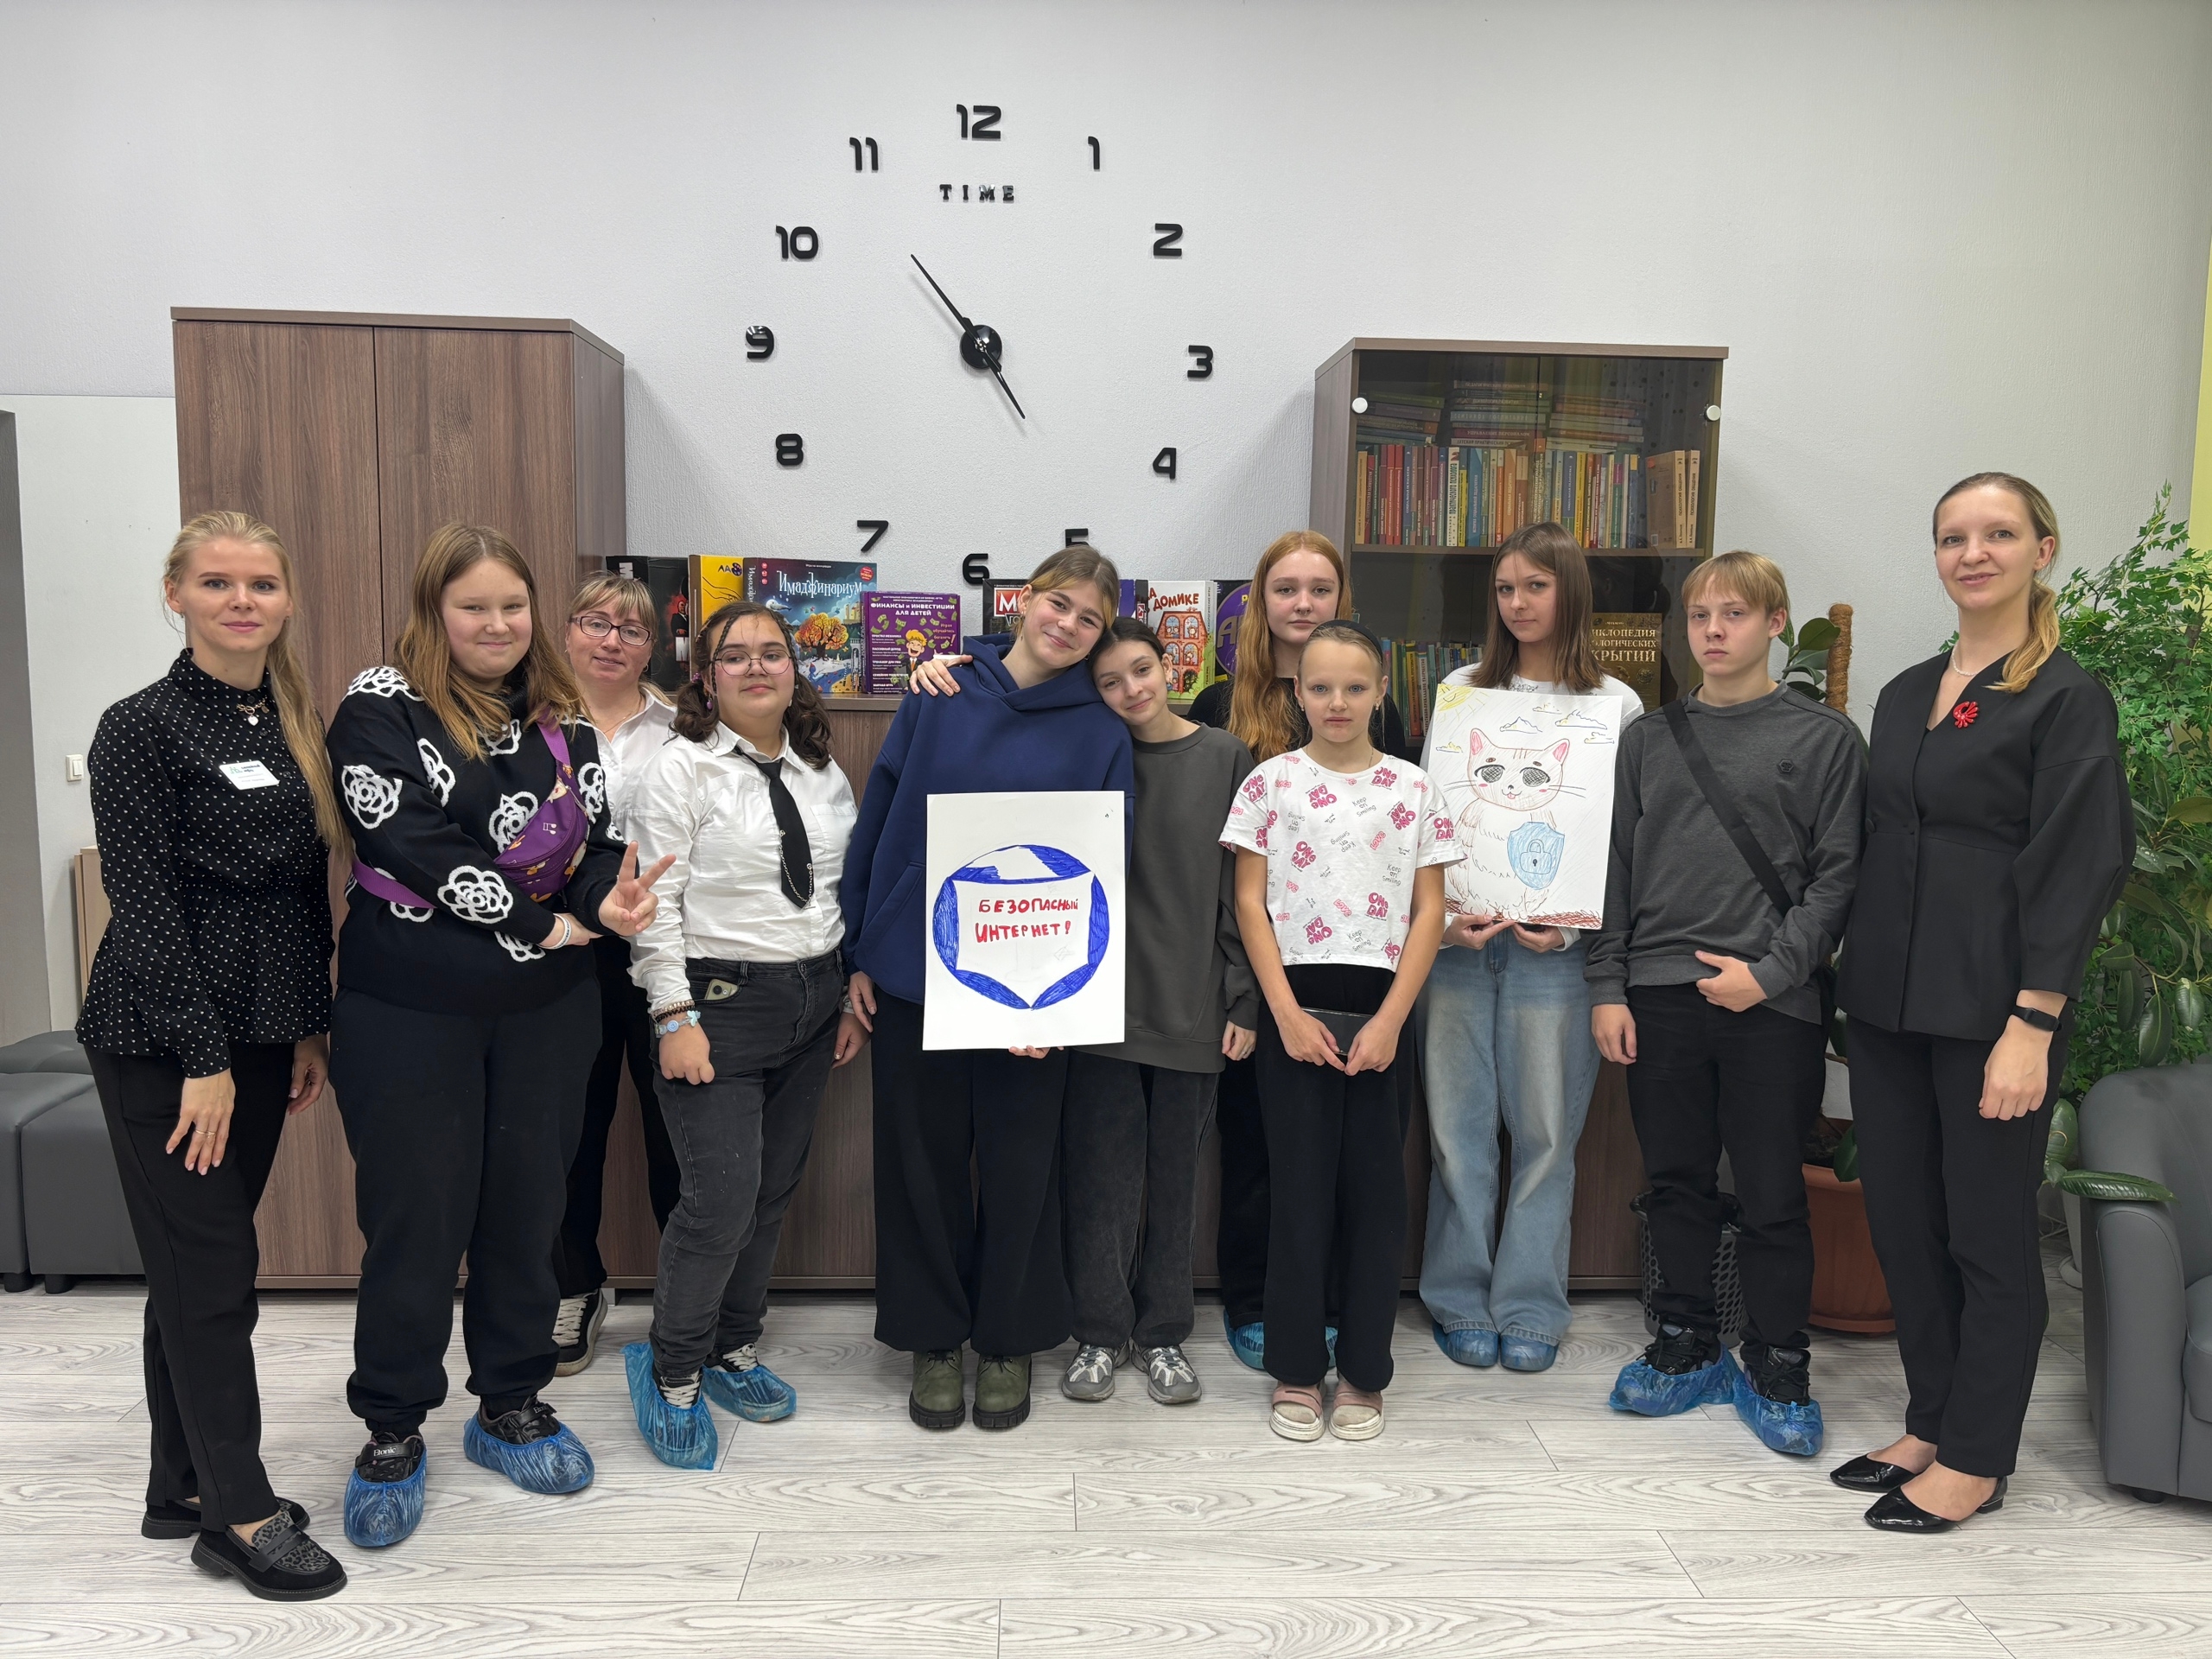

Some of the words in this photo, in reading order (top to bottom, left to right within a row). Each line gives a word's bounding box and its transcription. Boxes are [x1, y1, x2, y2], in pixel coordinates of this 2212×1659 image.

[957, 105, 1001, 139] 12
[849, 137, 878, 171] 11
[1088, 136, 1100, 170] 1
[939, 184, 1014, 201] TIME
[776, 226, 818, 259] 10
[1153, 223, 1183, 257] 2
[746, 326, 774, 359] 9
[1187, 345, 1214, 378] 3
[775, 434, 804, 466] 8
[1152, 448, 1177, 480] 4
[857, 520, 889, 553] 7
[747, 566, 757, 602] Имаджи
[963, 554, 989, 585] 6
[1153, 593, 1199, 612] ДОМИКЕ
[1592, 649, 1656, 662] КРЫТИЙ
[978, 898, 1078, 913] БЕЗОПАСНЫЙ
[1367, 905, 1388, 918] DAY
